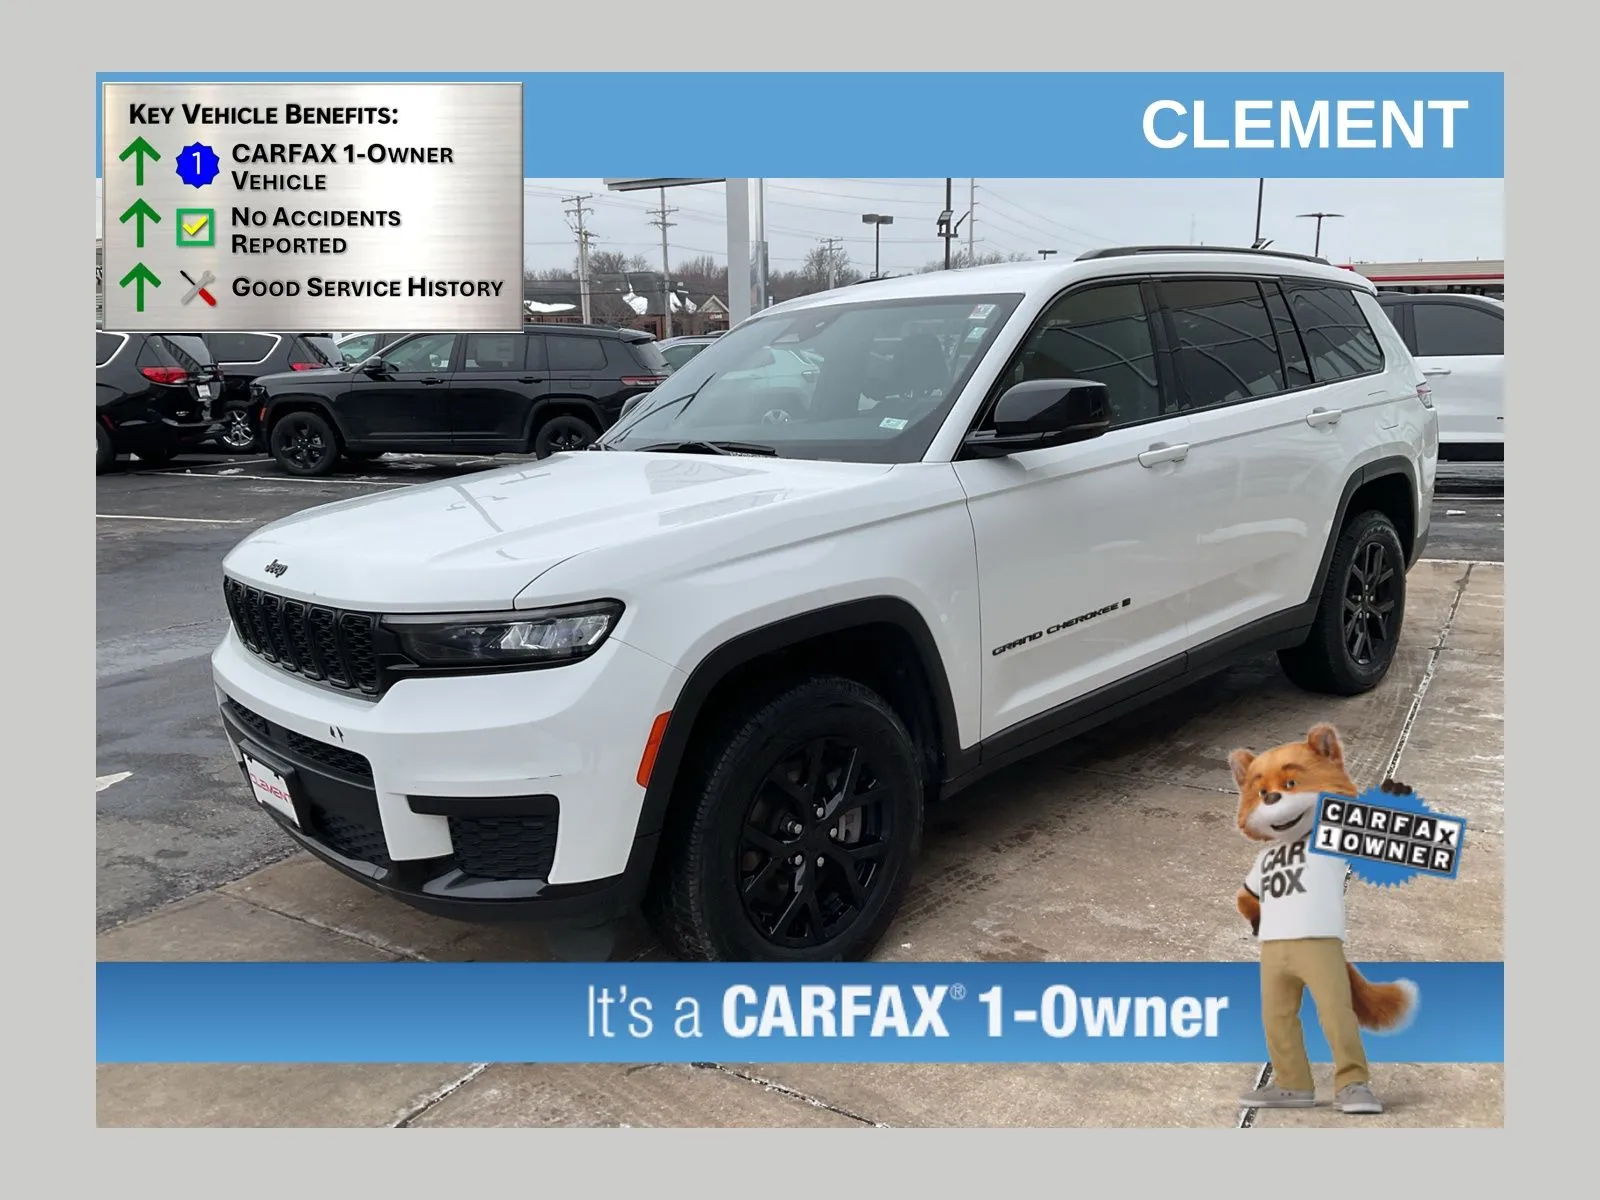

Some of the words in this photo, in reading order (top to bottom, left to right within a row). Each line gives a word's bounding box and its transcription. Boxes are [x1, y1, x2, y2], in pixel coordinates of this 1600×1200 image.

[264, 558, 289, 579] Jeep
[991, 630, 1043, 656] GRAND
[1046, 602, 1119, 635] CHEROKEE
